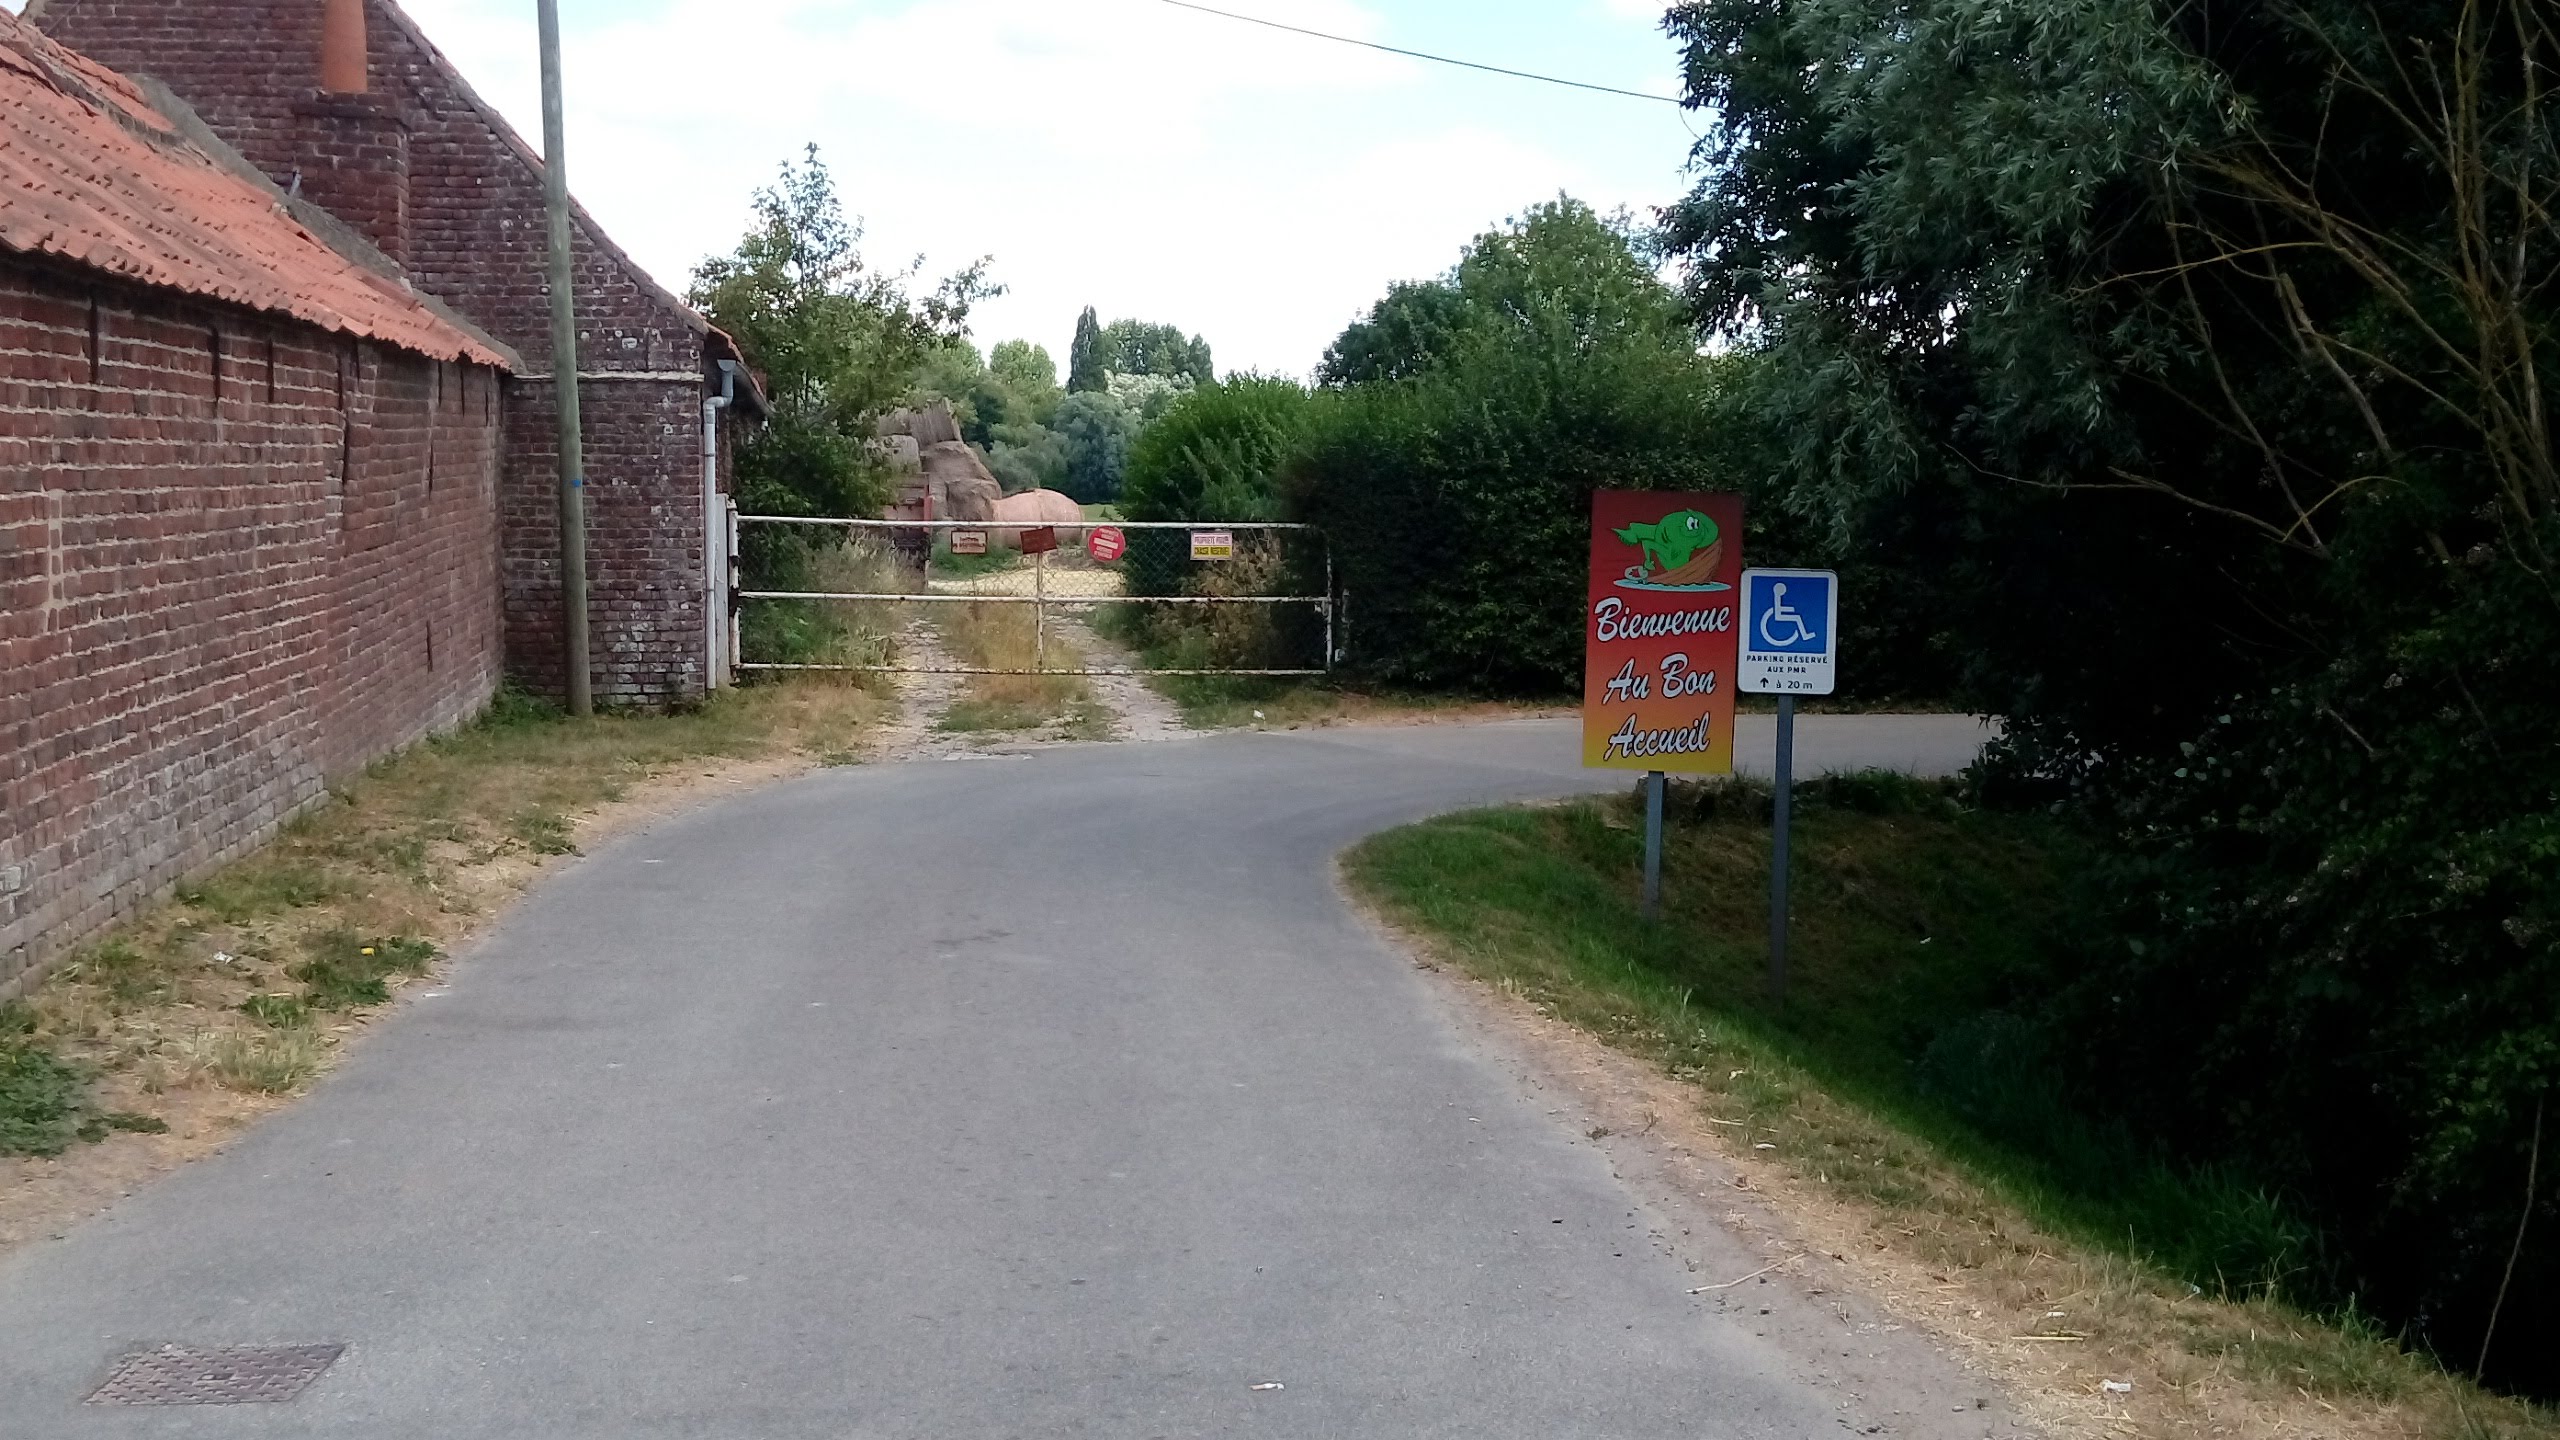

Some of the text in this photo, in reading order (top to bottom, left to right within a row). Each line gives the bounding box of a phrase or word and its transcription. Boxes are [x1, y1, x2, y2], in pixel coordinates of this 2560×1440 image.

[1594, 597, 1730, 642] Bienvenue
[1602, 653, 1717, 705] Au Bon
[1776, 680, 1782, 689] à
[1787, 680, 1801, 689] 20
[1603, 712, 1711, 761] Accueil
